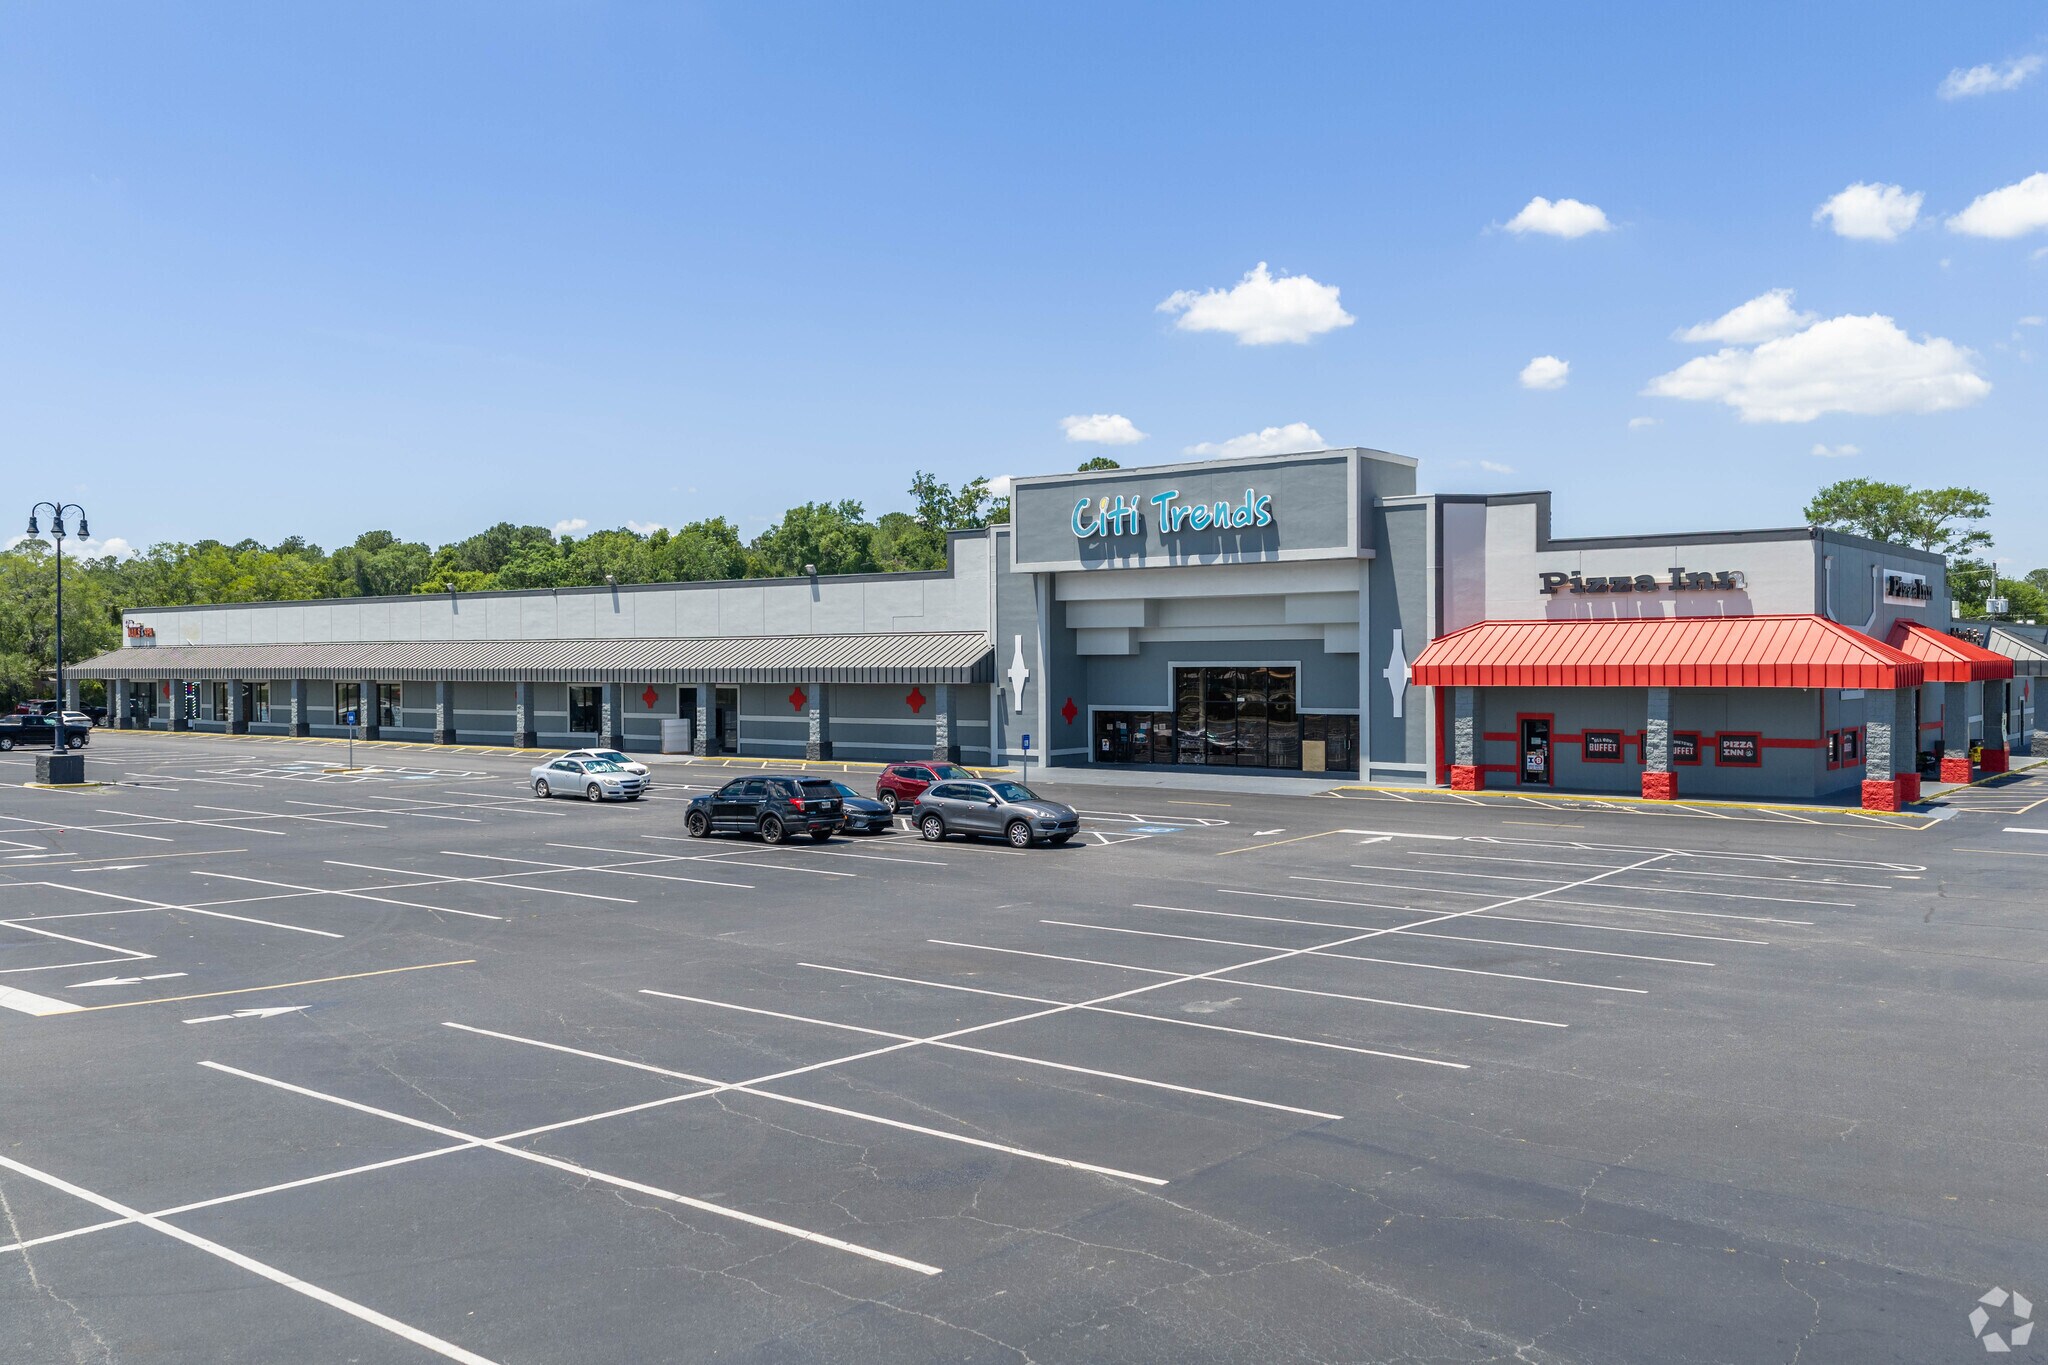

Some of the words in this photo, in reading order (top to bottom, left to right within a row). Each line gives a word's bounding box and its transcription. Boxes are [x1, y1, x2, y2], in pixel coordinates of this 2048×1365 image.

[1071, 495, 1141, 538] Citi
[1150, 488, 1272, 534] Trends
[1539, 570, 1660, 595] Pizza
[1668, 567, 1748, 590] Inn
[1589, 743, 1617, 752] BUFFET
[1673, 747, 1694, 755] UFFET
